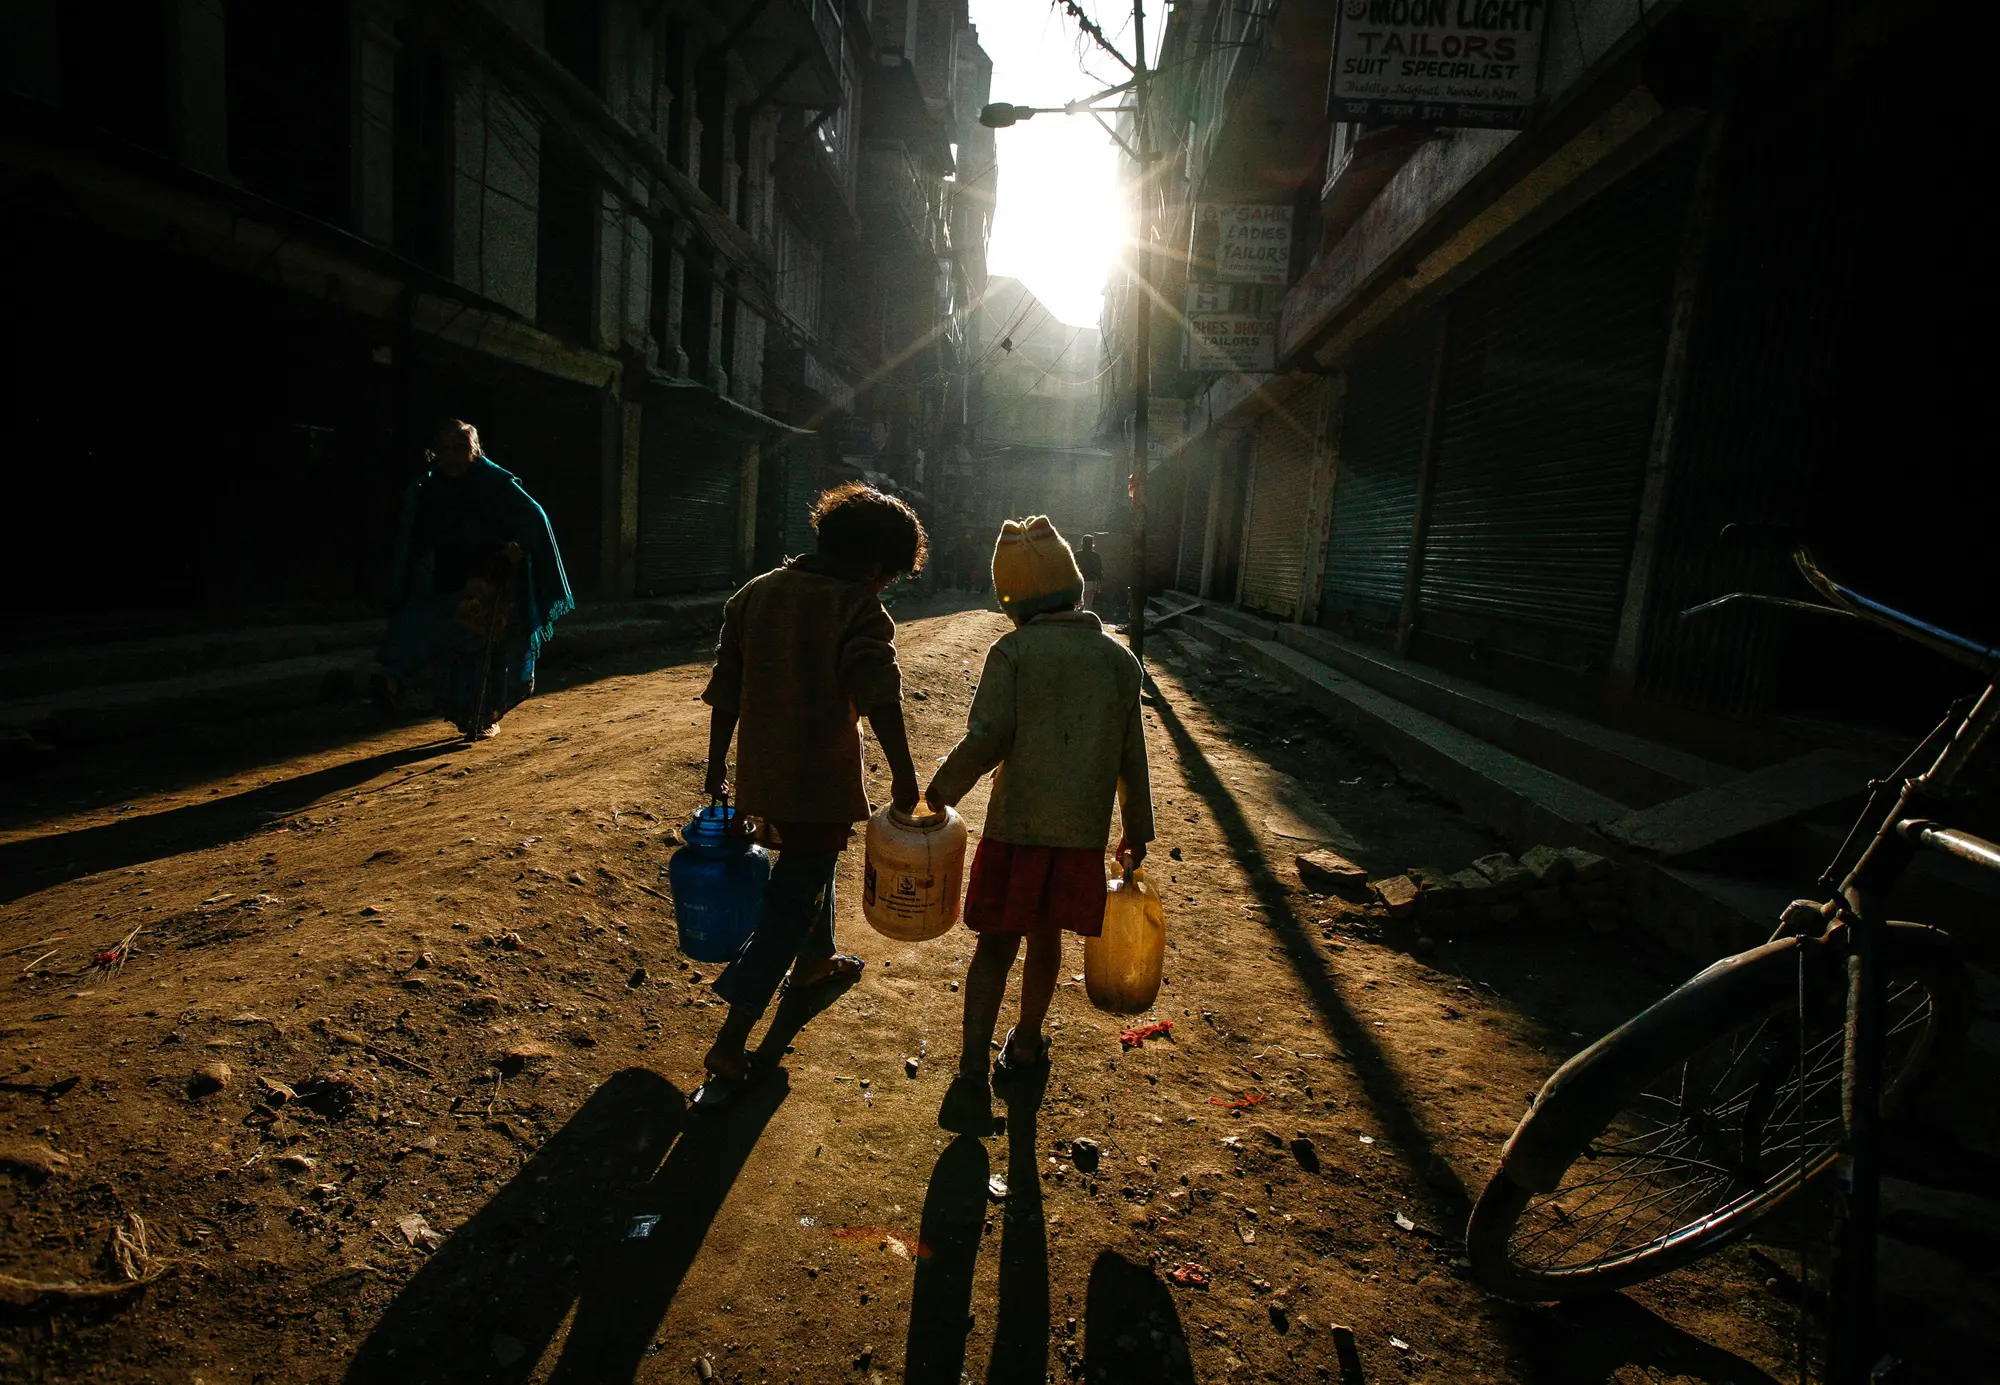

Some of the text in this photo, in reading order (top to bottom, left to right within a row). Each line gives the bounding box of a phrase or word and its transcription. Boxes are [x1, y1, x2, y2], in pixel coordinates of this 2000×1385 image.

[1369, 0, 1543, 31] MOON LIGHT
[1358, 33, 1516, 60] TAILORS
[1343, 58, 1519, 80] SUIT SPECIALIST
[1227, 223, 1288, 240] LADIES
[1224, 243, 1288, 263] TAILORS
[1202, 336, 1260, 346] TAILORS
